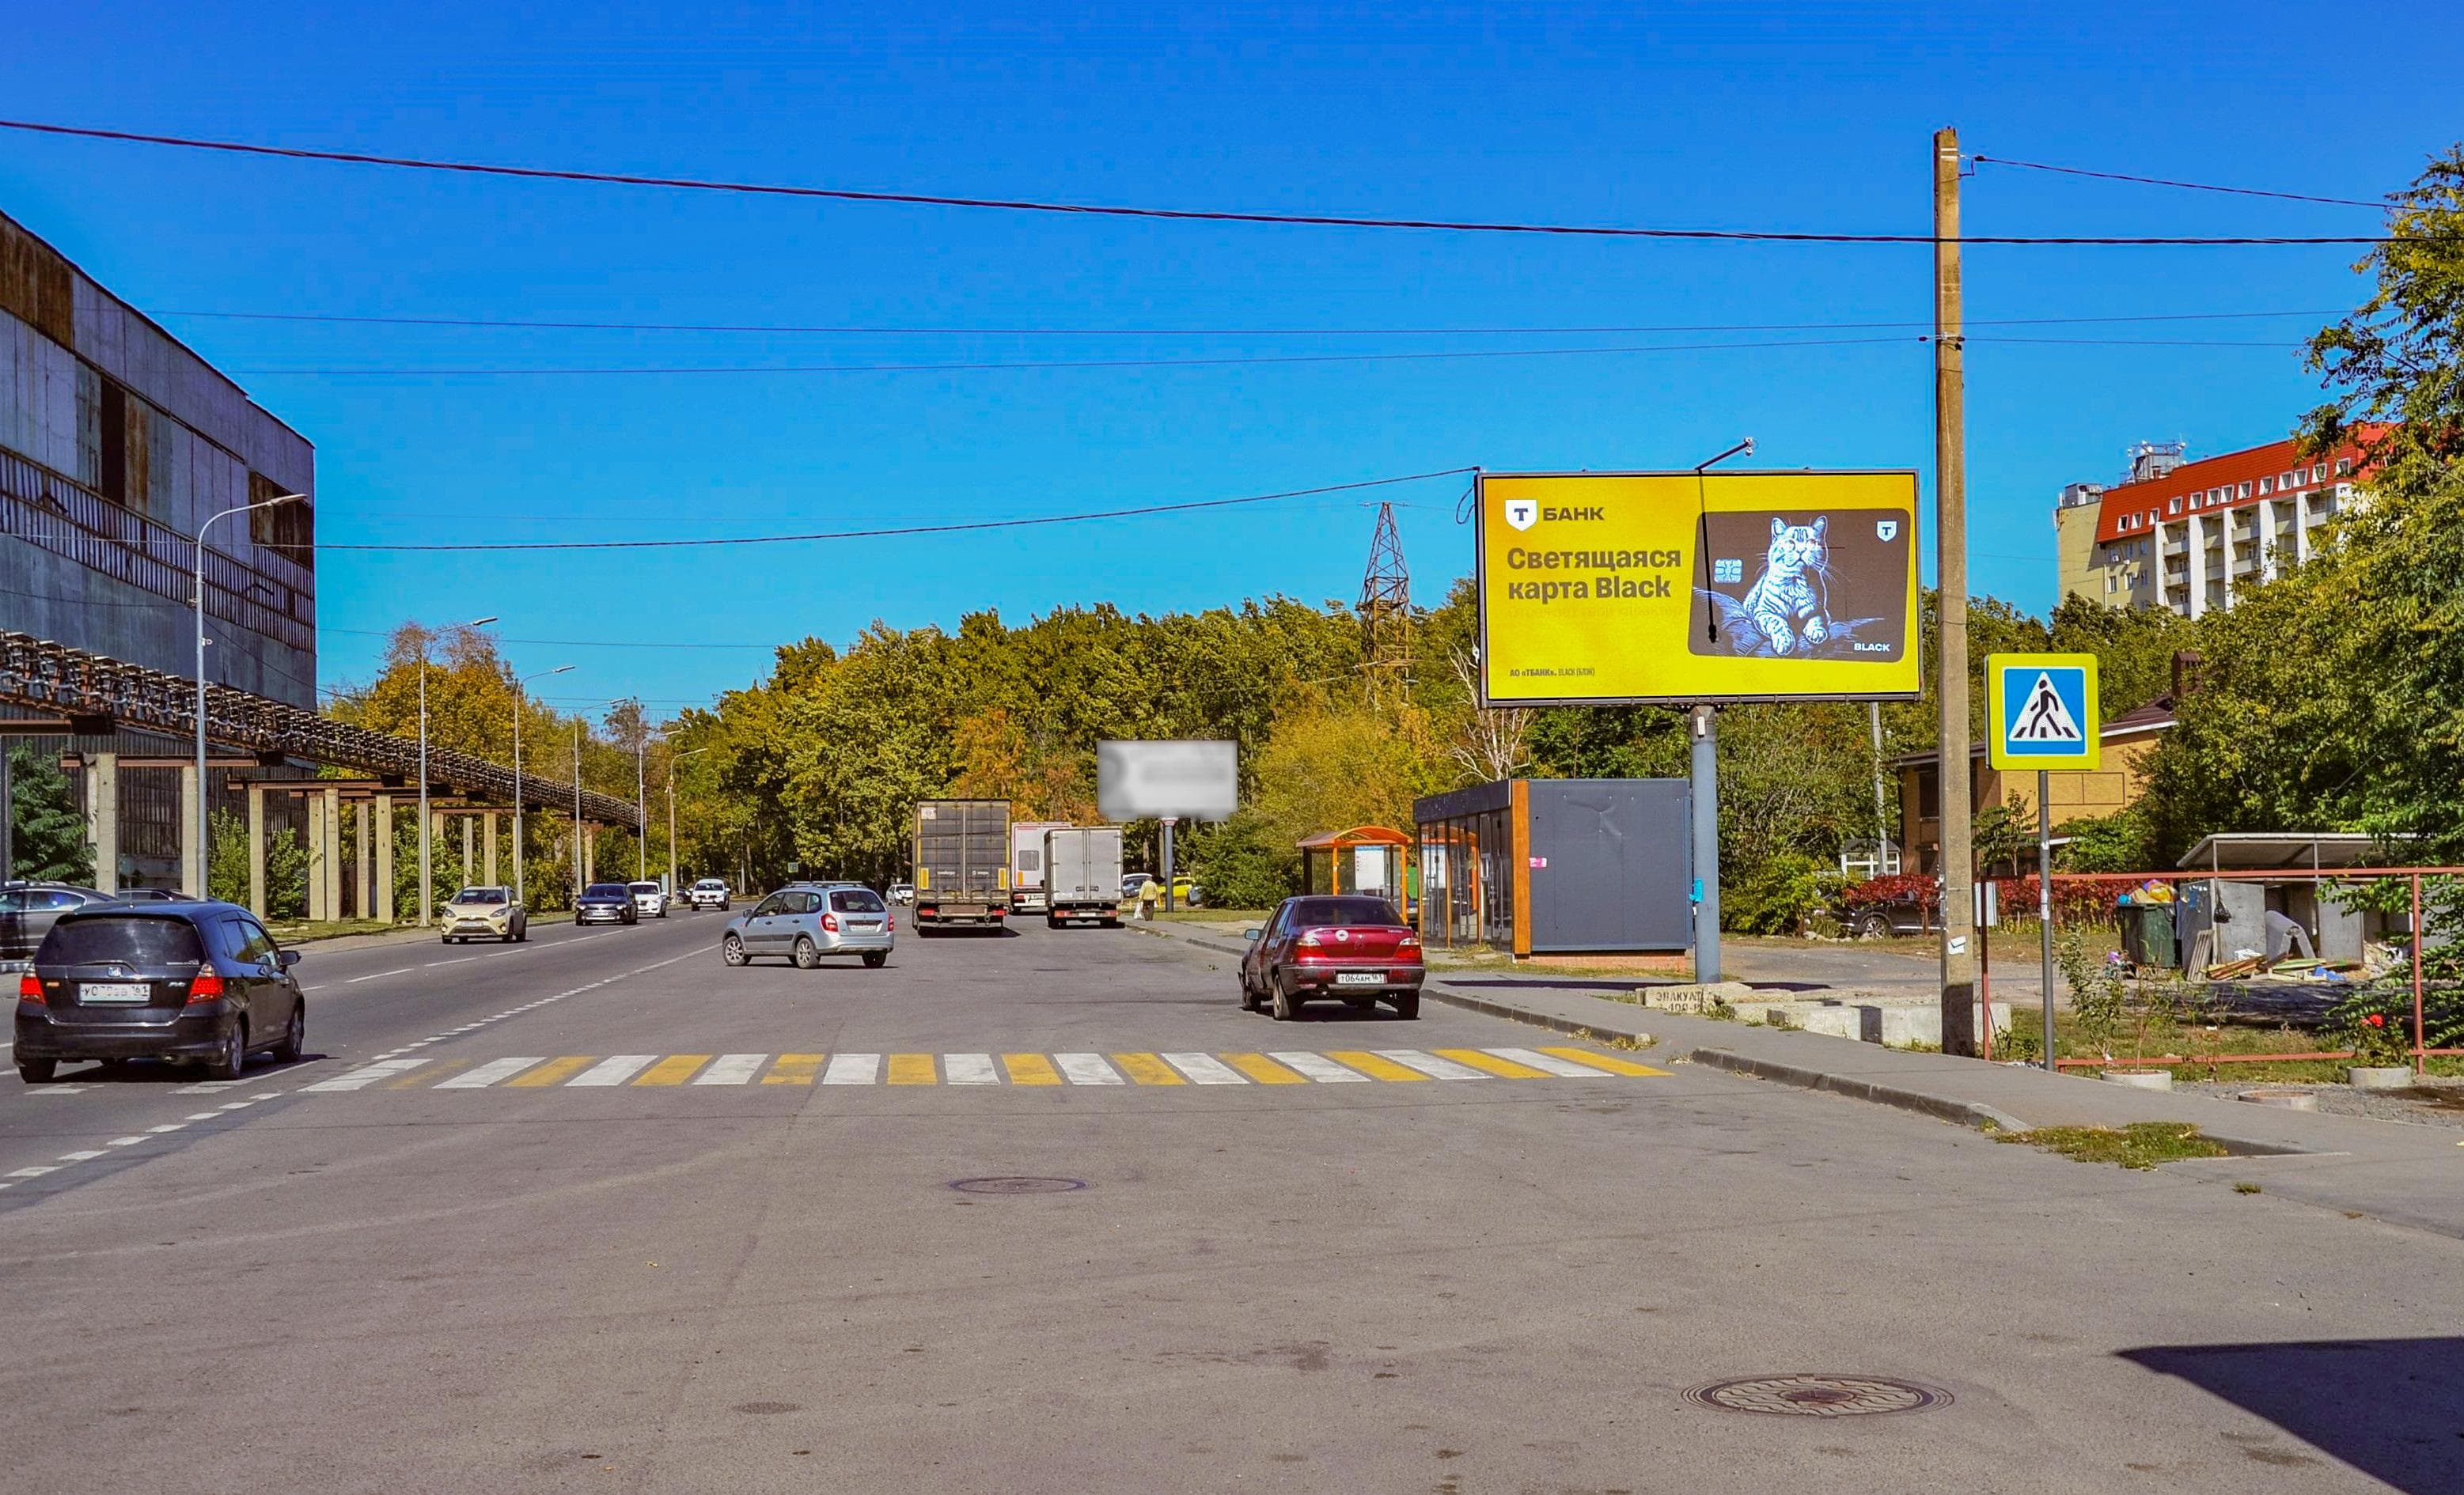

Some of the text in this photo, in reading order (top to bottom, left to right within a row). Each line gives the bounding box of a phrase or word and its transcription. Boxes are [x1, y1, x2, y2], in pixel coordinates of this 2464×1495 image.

[1543, 507, 1605, 521] БАНК
[1507, 547, 1681, 571] Светящаяся
[1508, 575, 1671, 604] карта Black
[1854, 642, 1890, 652] BLACK
